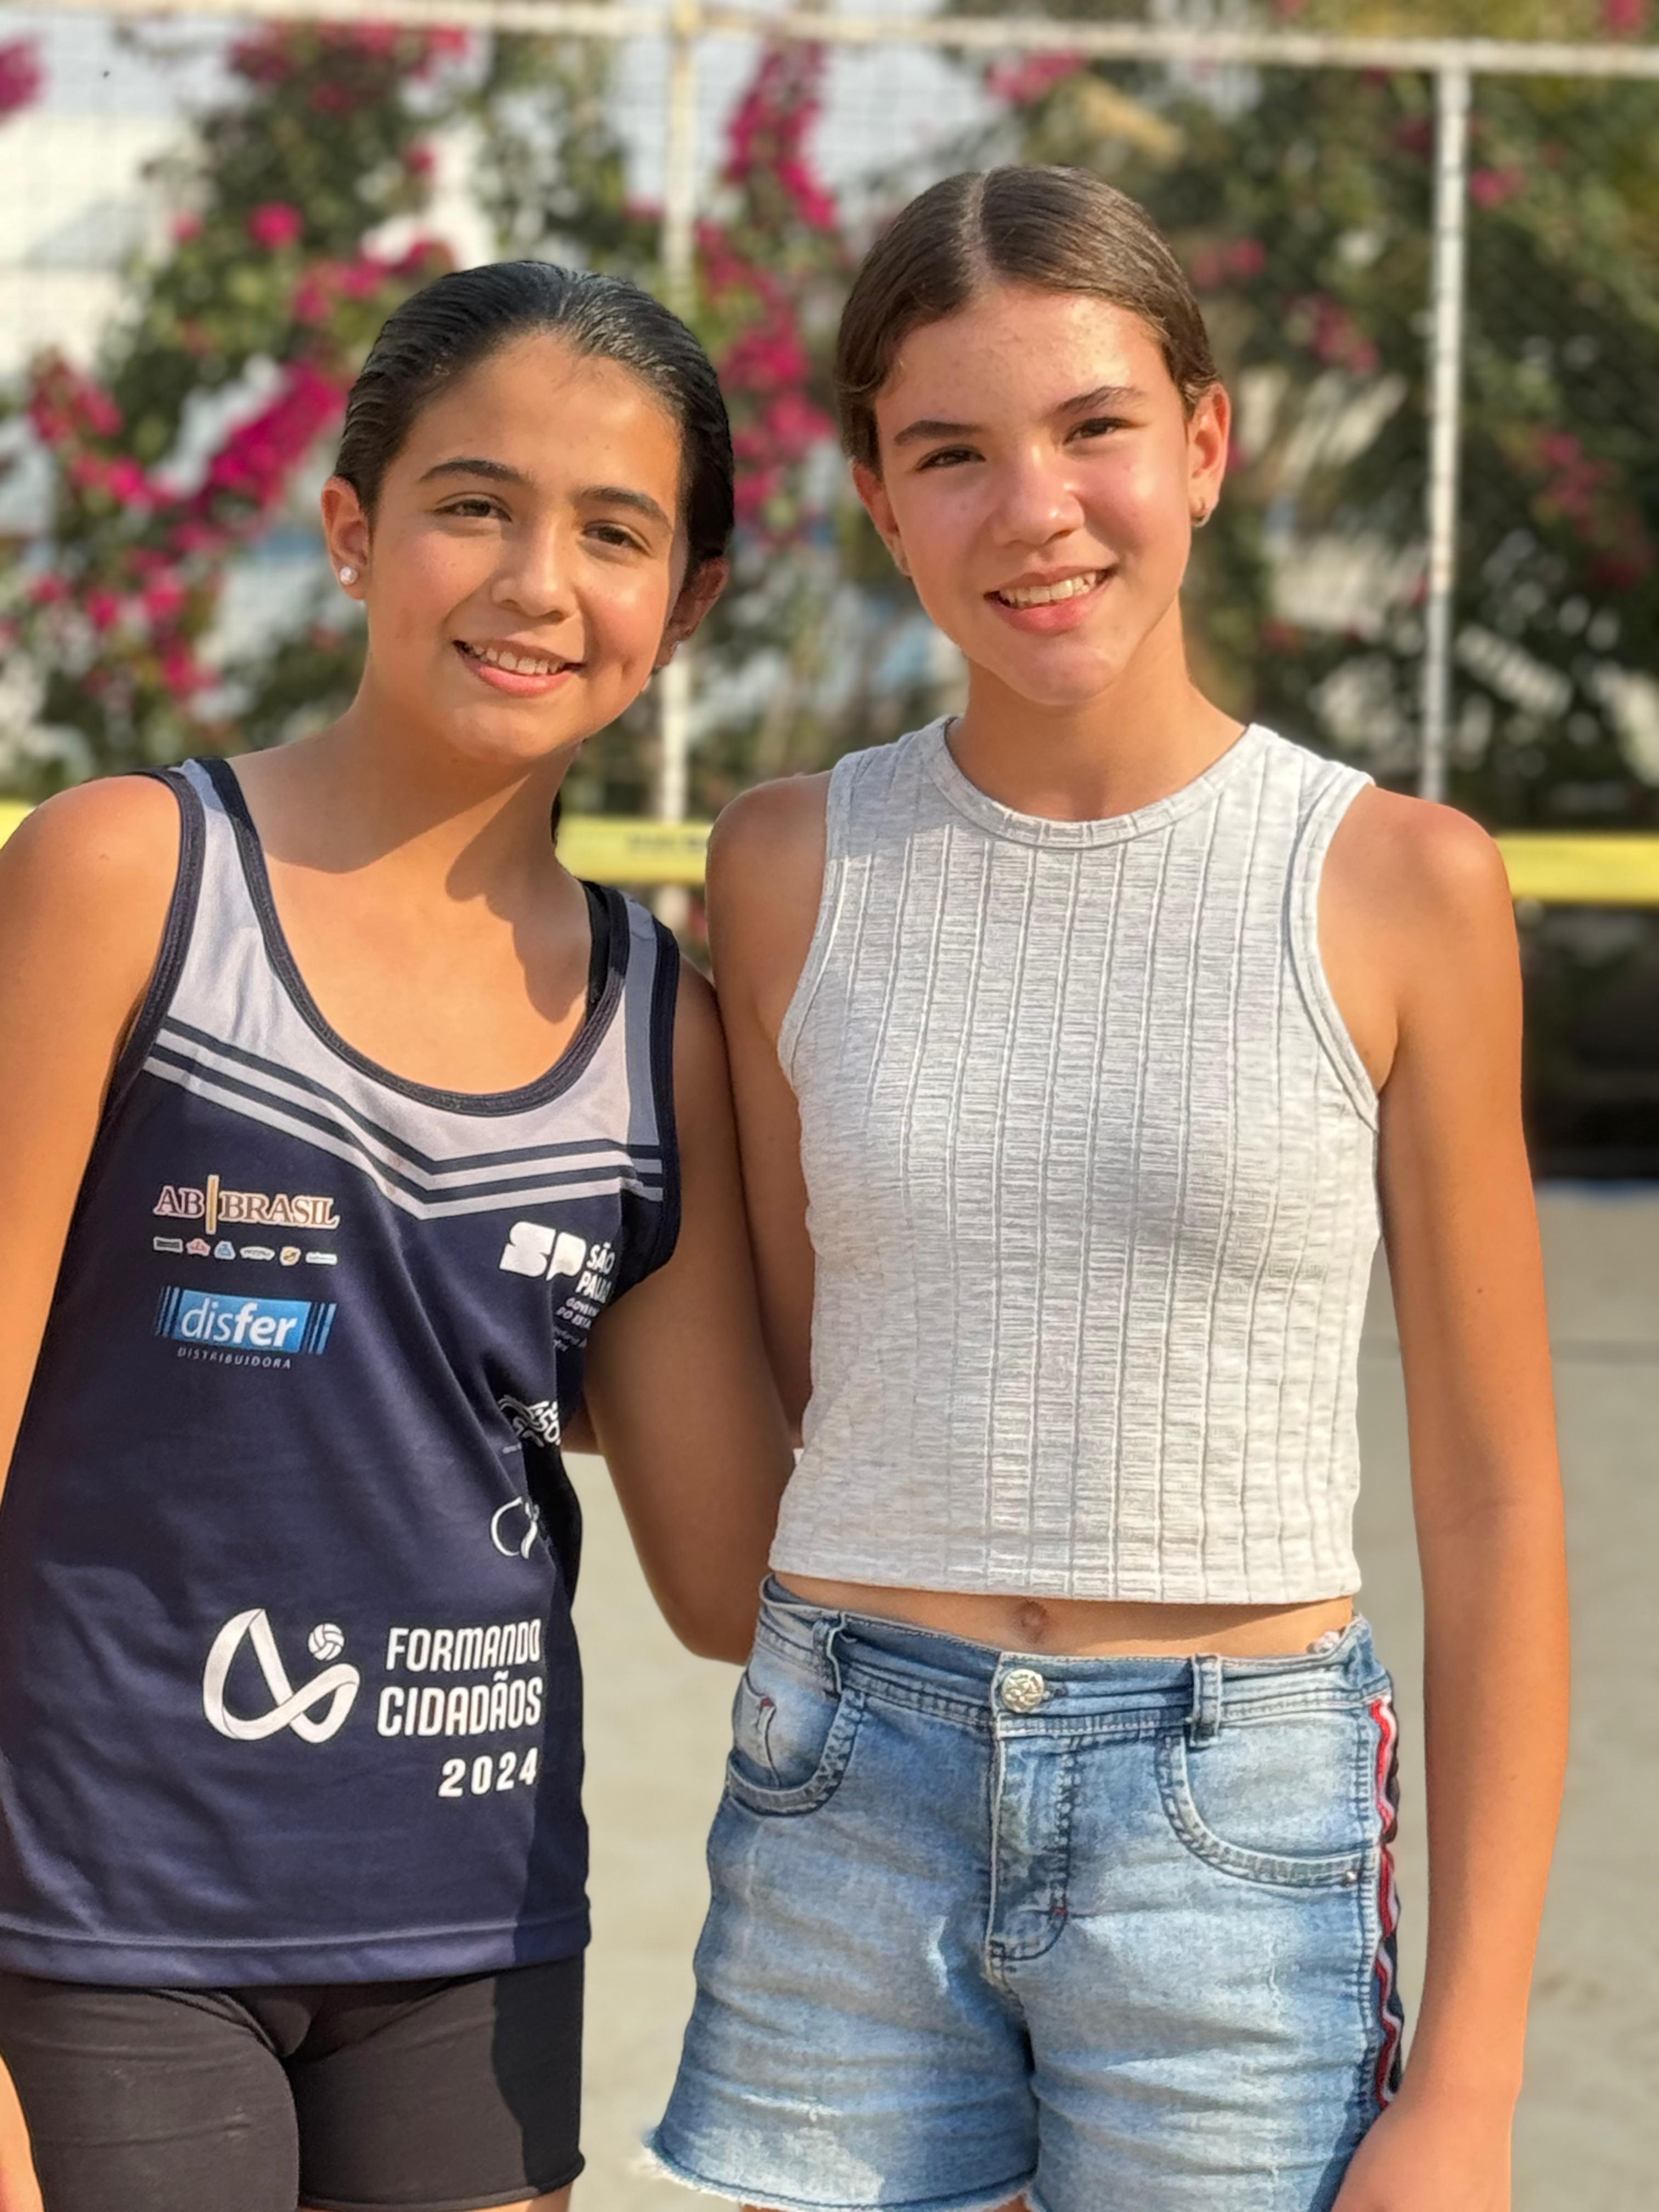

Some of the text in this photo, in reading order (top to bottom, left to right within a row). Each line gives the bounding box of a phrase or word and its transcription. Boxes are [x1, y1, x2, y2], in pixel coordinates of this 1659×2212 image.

[499, 1221, 586, 1282] SP
[181, 1297, 298, 1347] disfer
[177, 1346, 291, 1369] DISTRIBUIDORA
[386, 1618, 541, 1672] FORMANDO
[377, 1670, 543, 1737] CIDADÃOS
[438, 1747, 538, 1798] 2024
